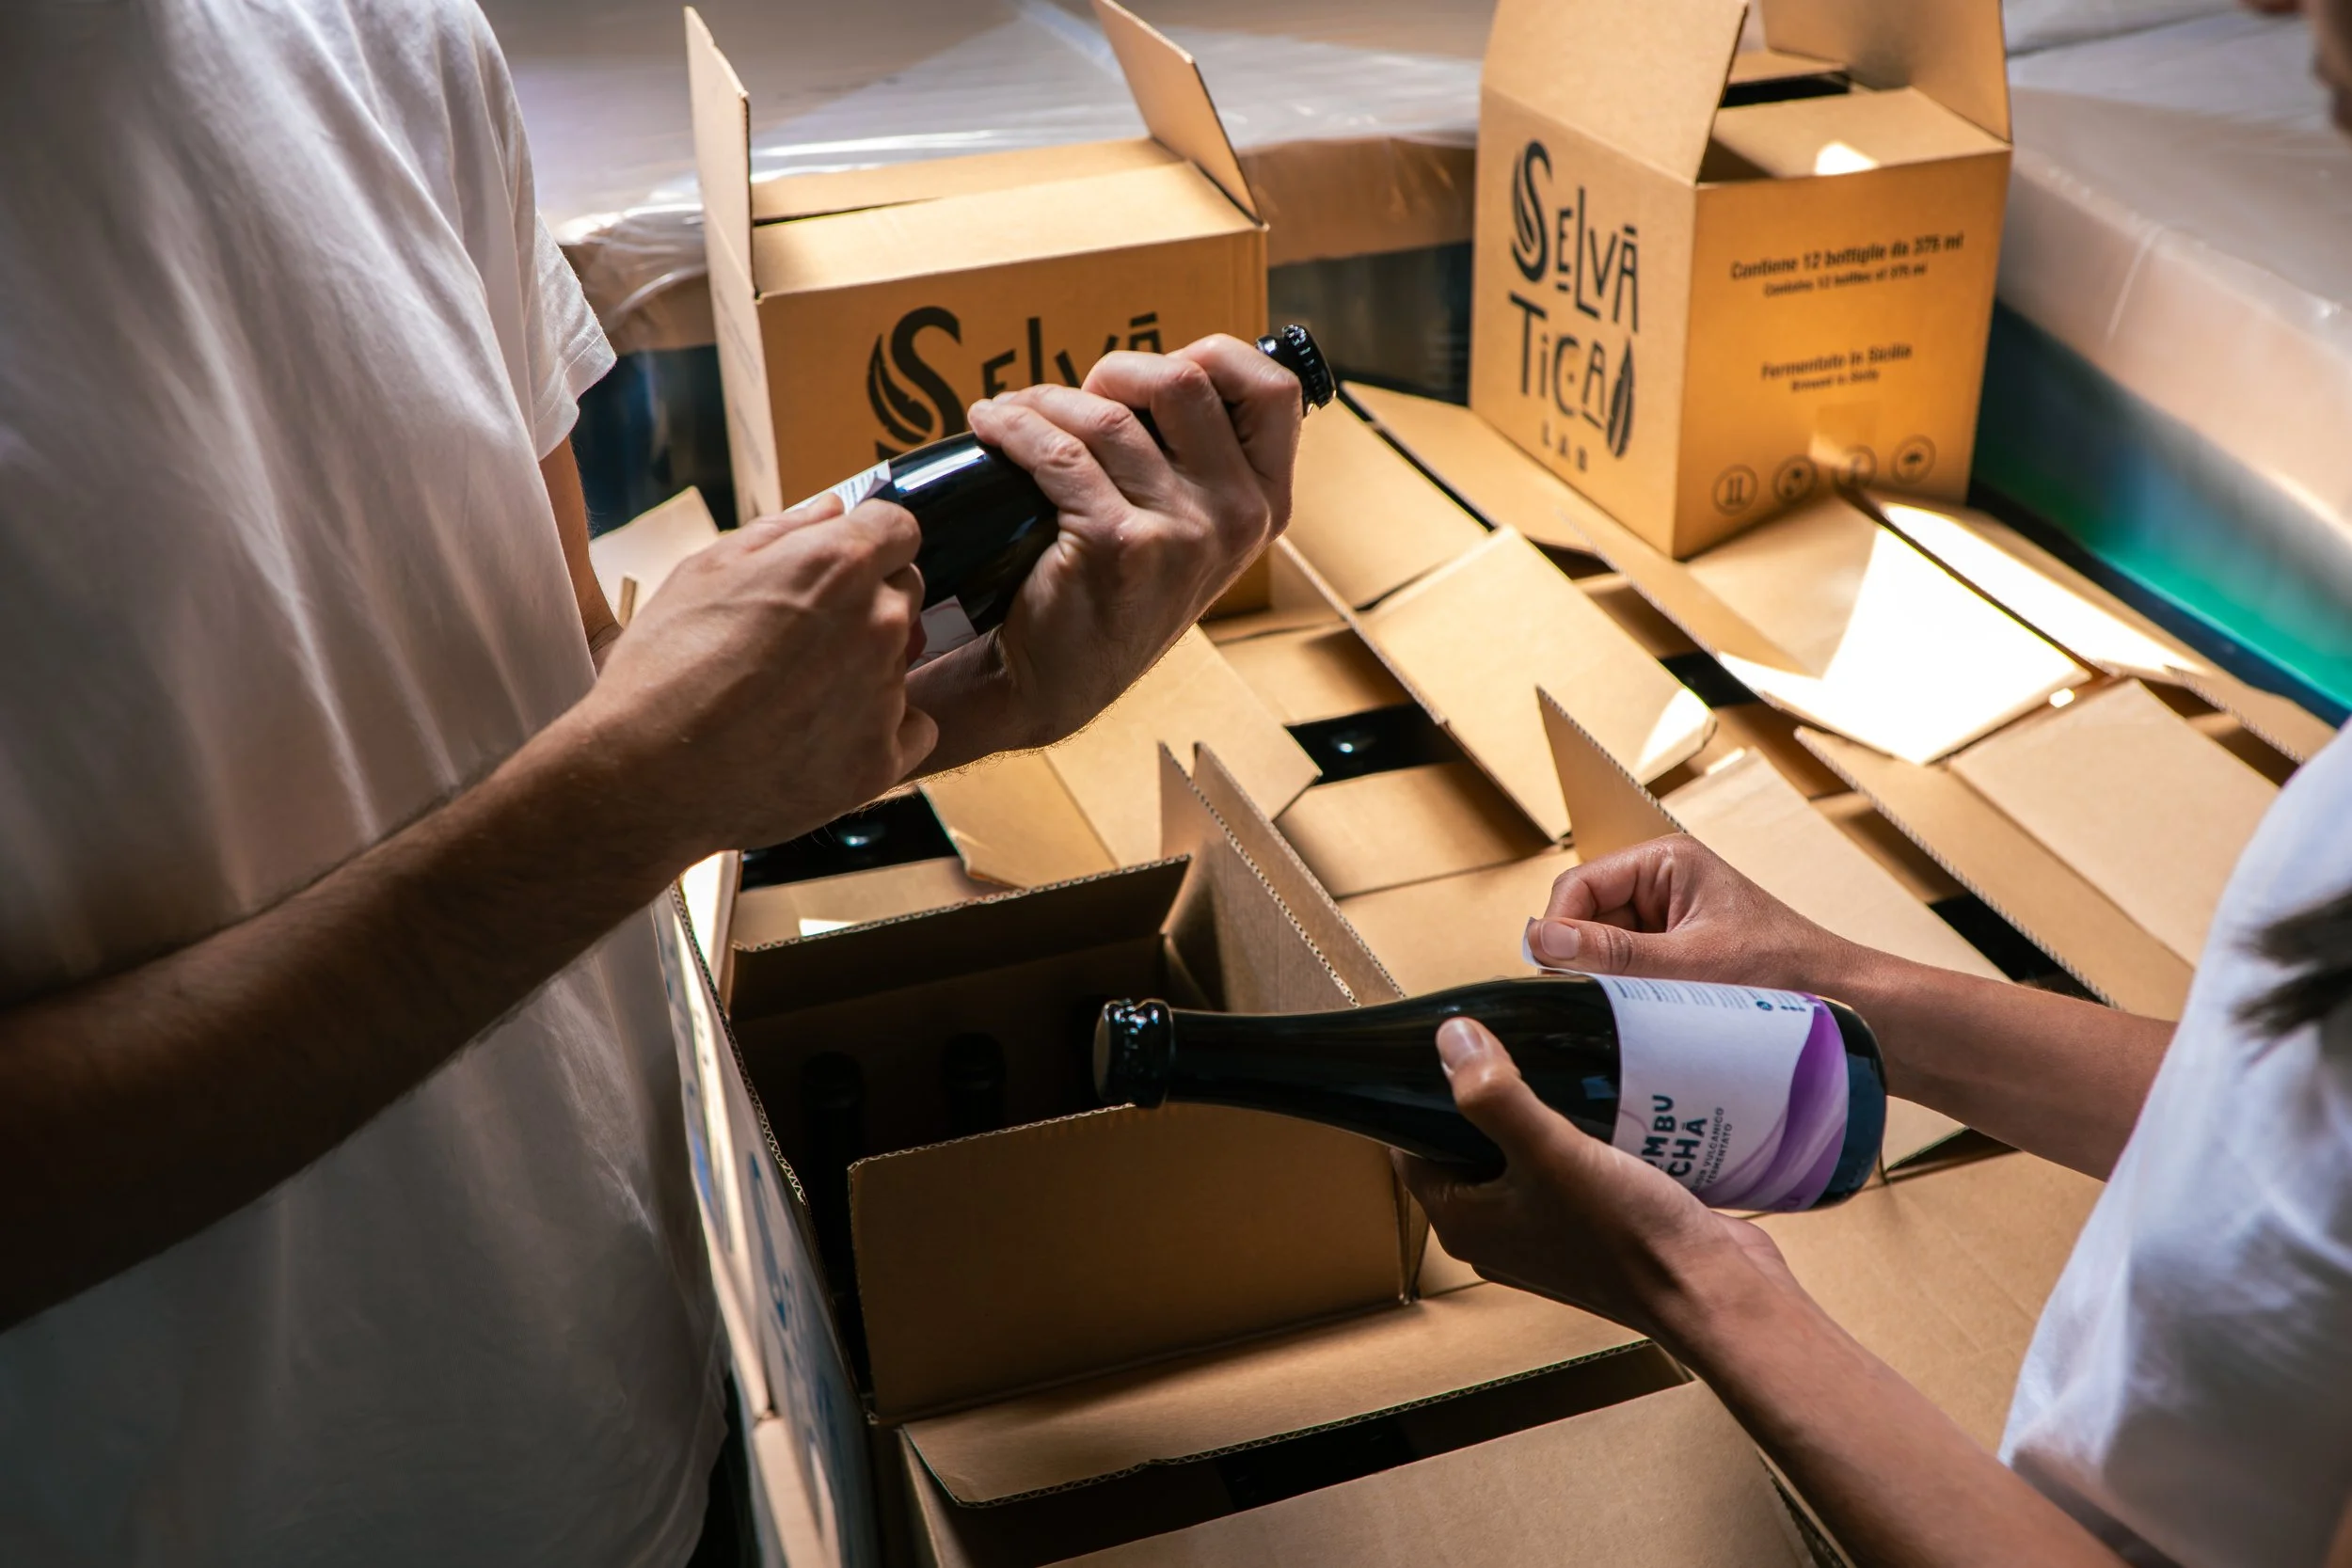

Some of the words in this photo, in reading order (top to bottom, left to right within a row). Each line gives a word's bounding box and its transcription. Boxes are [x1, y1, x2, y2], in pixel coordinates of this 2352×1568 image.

[1731, 258, 1798, 280] Contiene
[1804, 251, 1821, 269] 12
[1825, 244, 1886, 266] bottiglie
[1891, 239, 1909, 257] da
[1914, 234, 1941, 255] 375
[1945, 231, 1964, 250] ml
[1764, 279, 1814, 297] Contains
[1818, 277, 1831, 289] 12
[1835, 270, 1871, 287] bottles
[1761, 354, 1846, 379] Fermentato
[1851, 349, 1864, 366] in
[1868, 342, 1913, 363] Sicilia
[1541, 420, 1588, 473] LAB
[1642, 1094, 1677, 1167] MBU
[1704, 1107, 1724, 1166] VULCANICO
[1706, 1123, 1733, 1183] FERMENTATO
